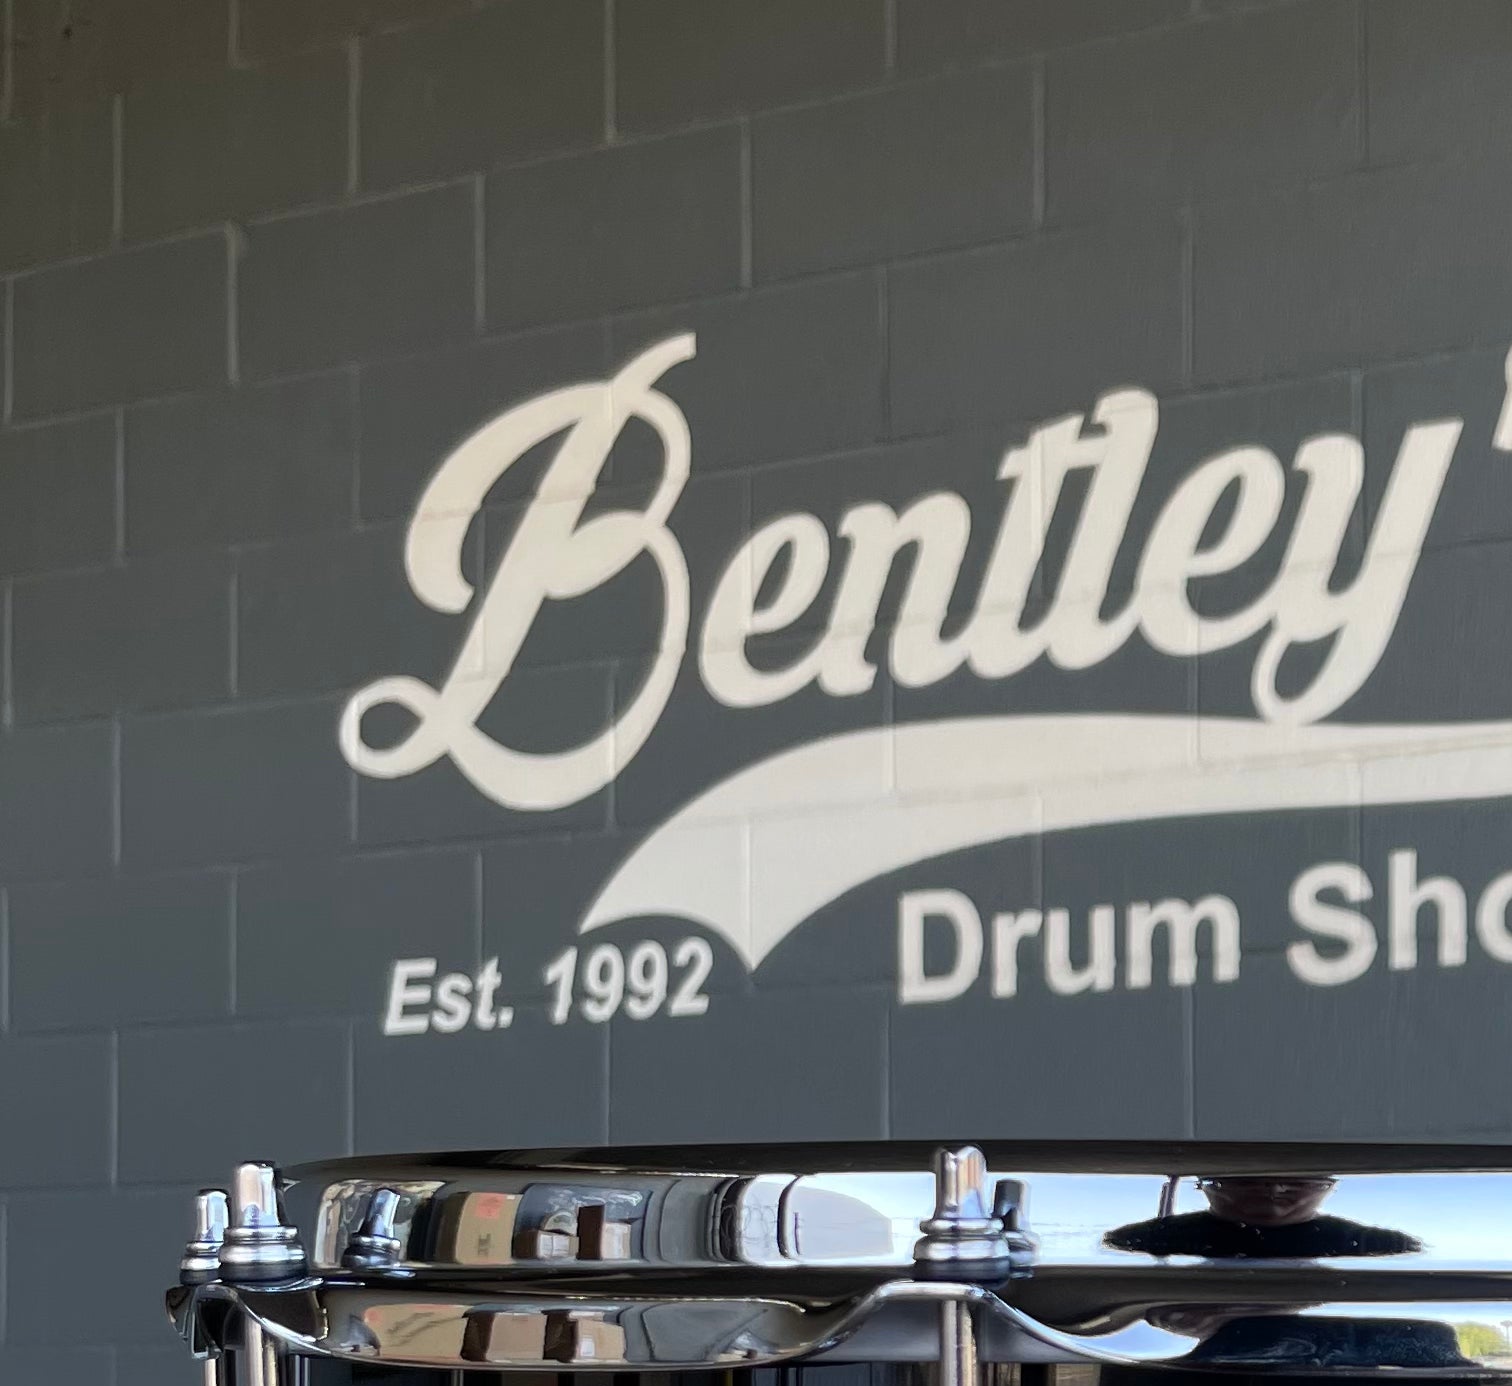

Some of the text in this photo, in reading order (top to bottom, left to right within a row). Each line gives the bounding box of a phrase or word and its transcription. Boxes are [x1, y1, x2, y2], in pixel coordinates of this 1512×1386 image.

[383, 936, 714, 1037] Est. 1992
[897, 887, 1242, 1005] Drum
